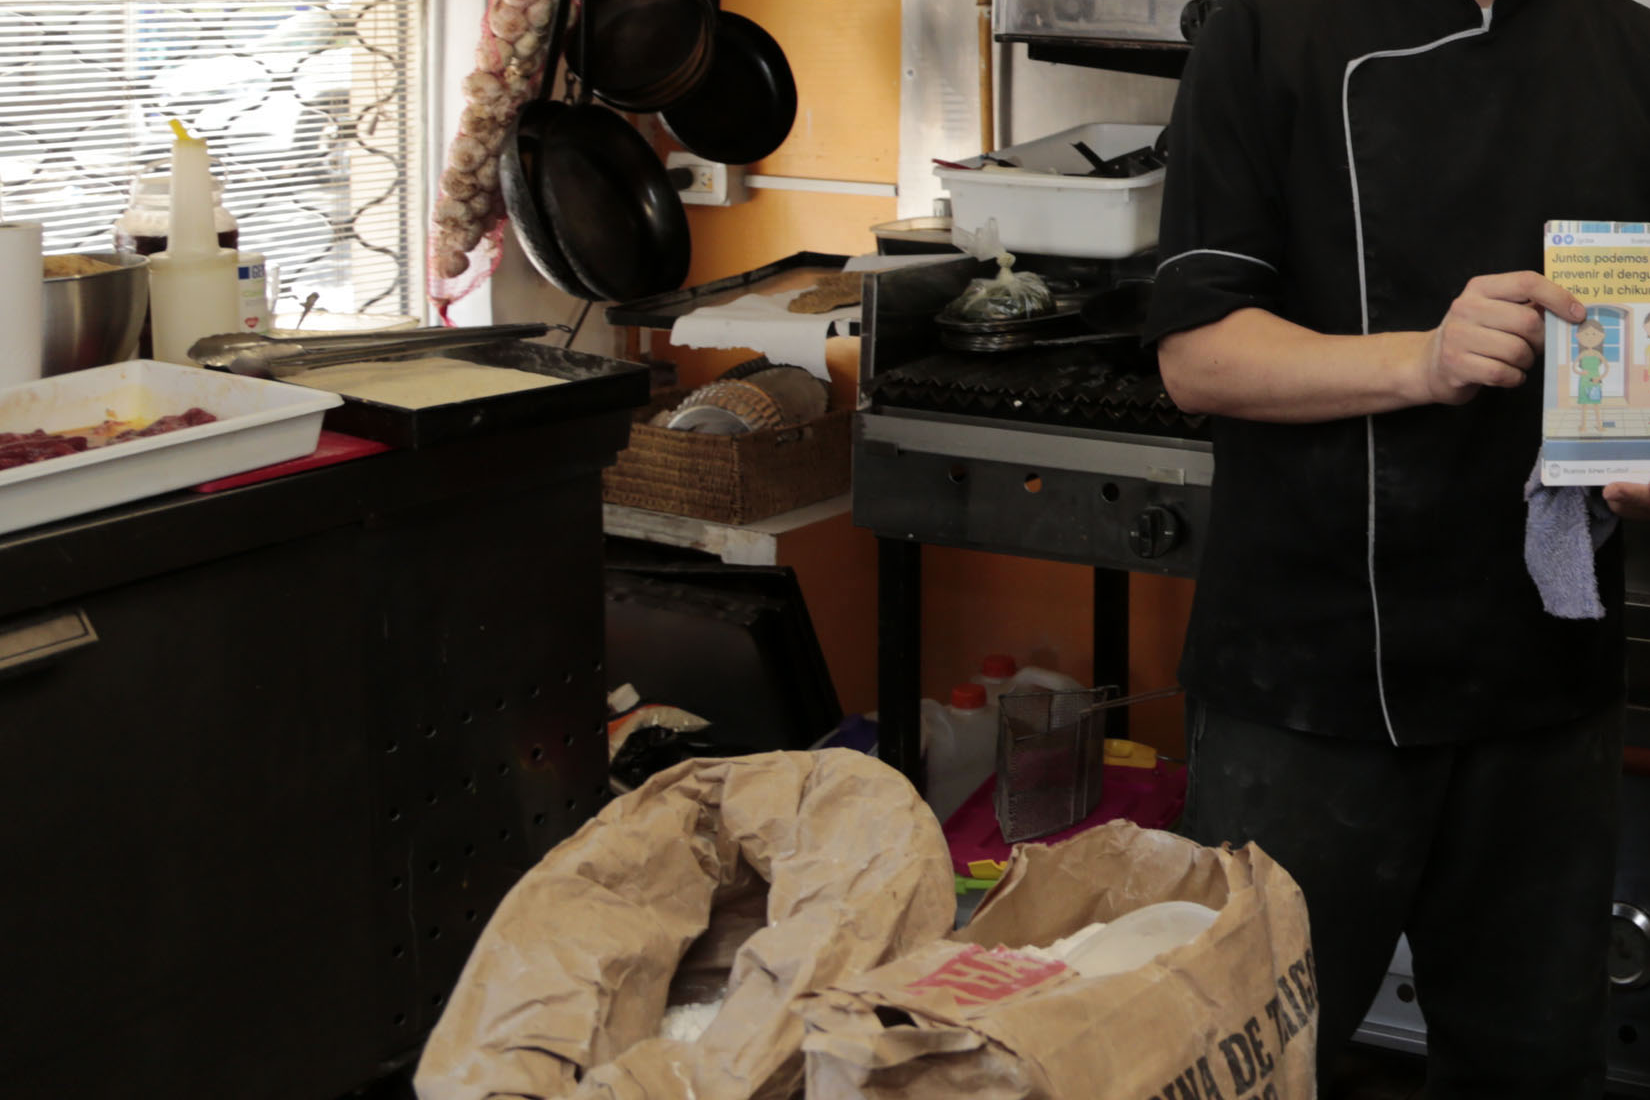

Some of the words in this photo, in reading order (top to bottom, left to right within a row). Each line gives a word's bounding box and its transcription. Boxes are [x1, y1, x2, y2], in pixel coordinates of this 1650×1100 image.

[1551, 253, 1591, 264] Juntos
[1594, 253, 1649, 267] podemos
[1552, 269, 1600, 283] prevenir
[1603, 269, 1614, 280] el
[1593, 287, 1600, 298] y
[1603, 285, 1614, 295] la
[1218, 1017, 1274, 1096] DE
